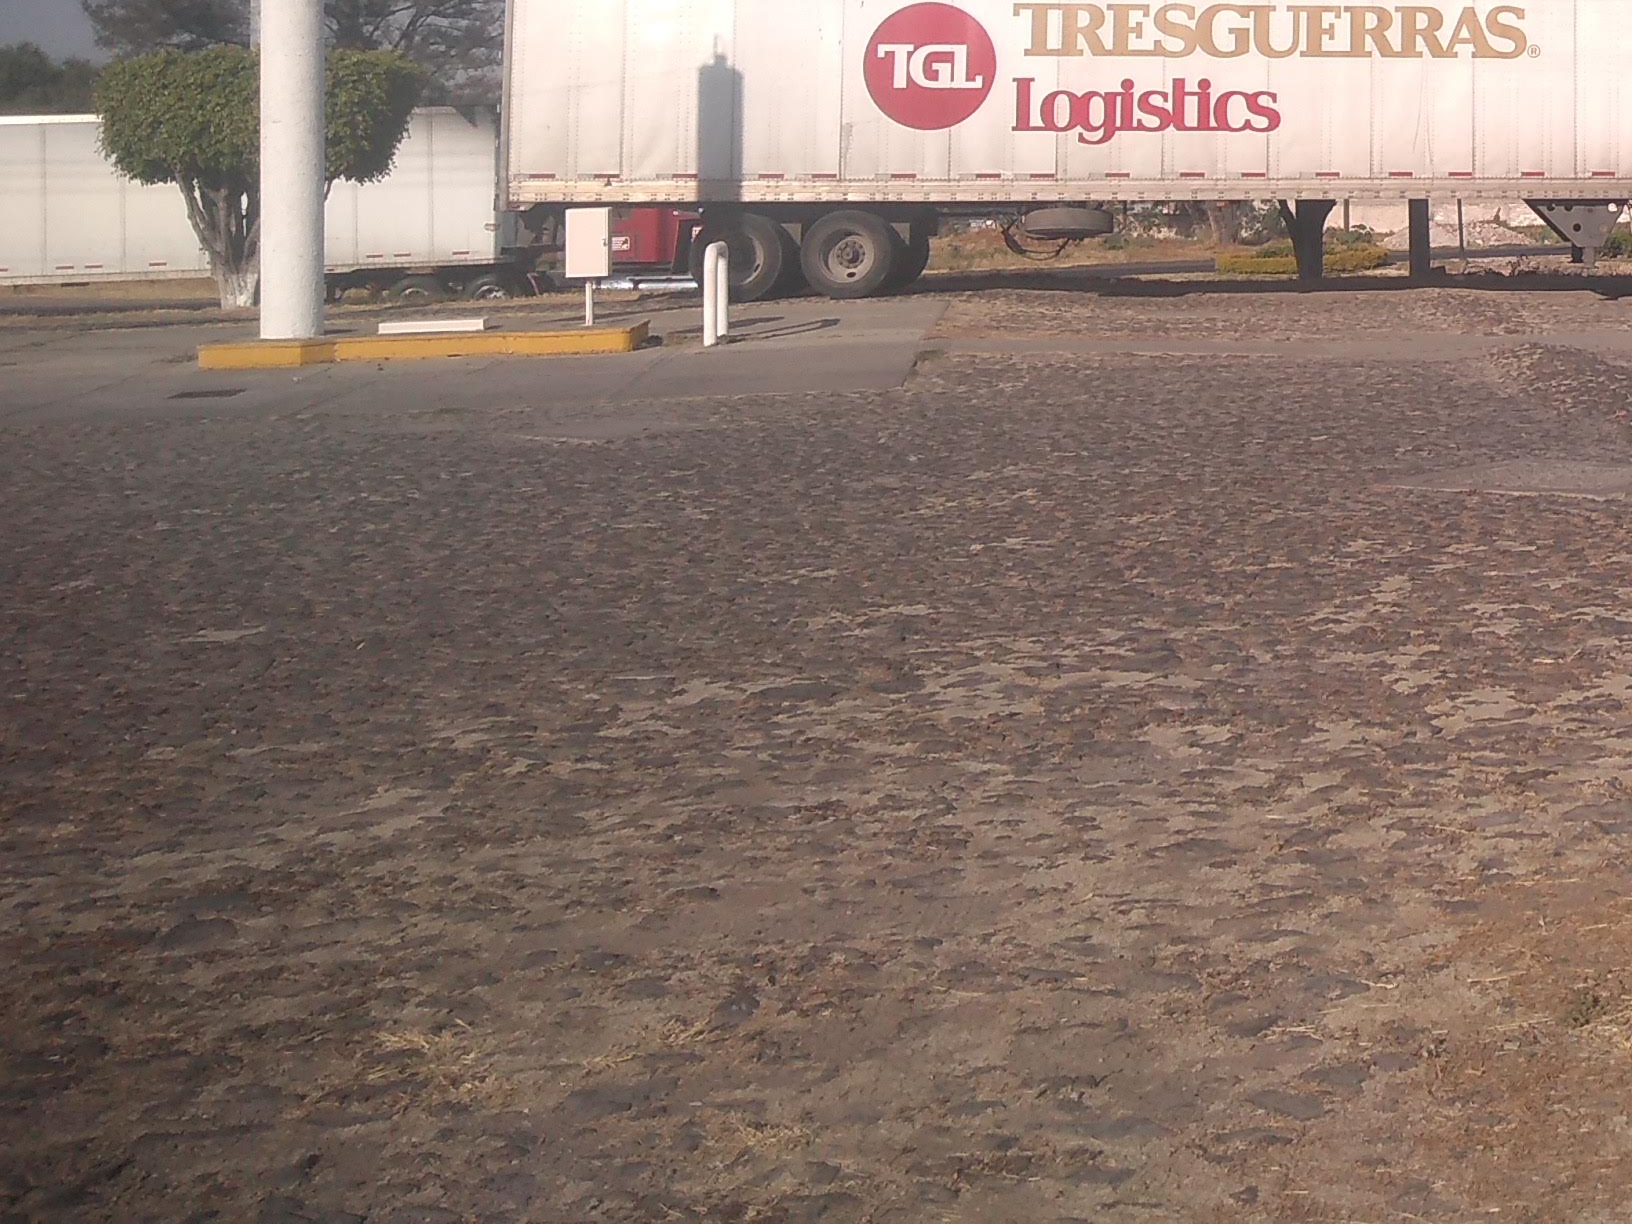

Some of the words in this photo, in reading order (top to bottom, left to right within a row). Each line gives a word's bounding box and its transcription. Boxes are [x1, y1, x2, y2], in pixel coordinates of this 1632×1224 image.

[1013, 3, 1528, 59] TRESGUERRAS
[877, 44, 983, 89] TGL
[1012, 77, 1282, 145] Logistics
